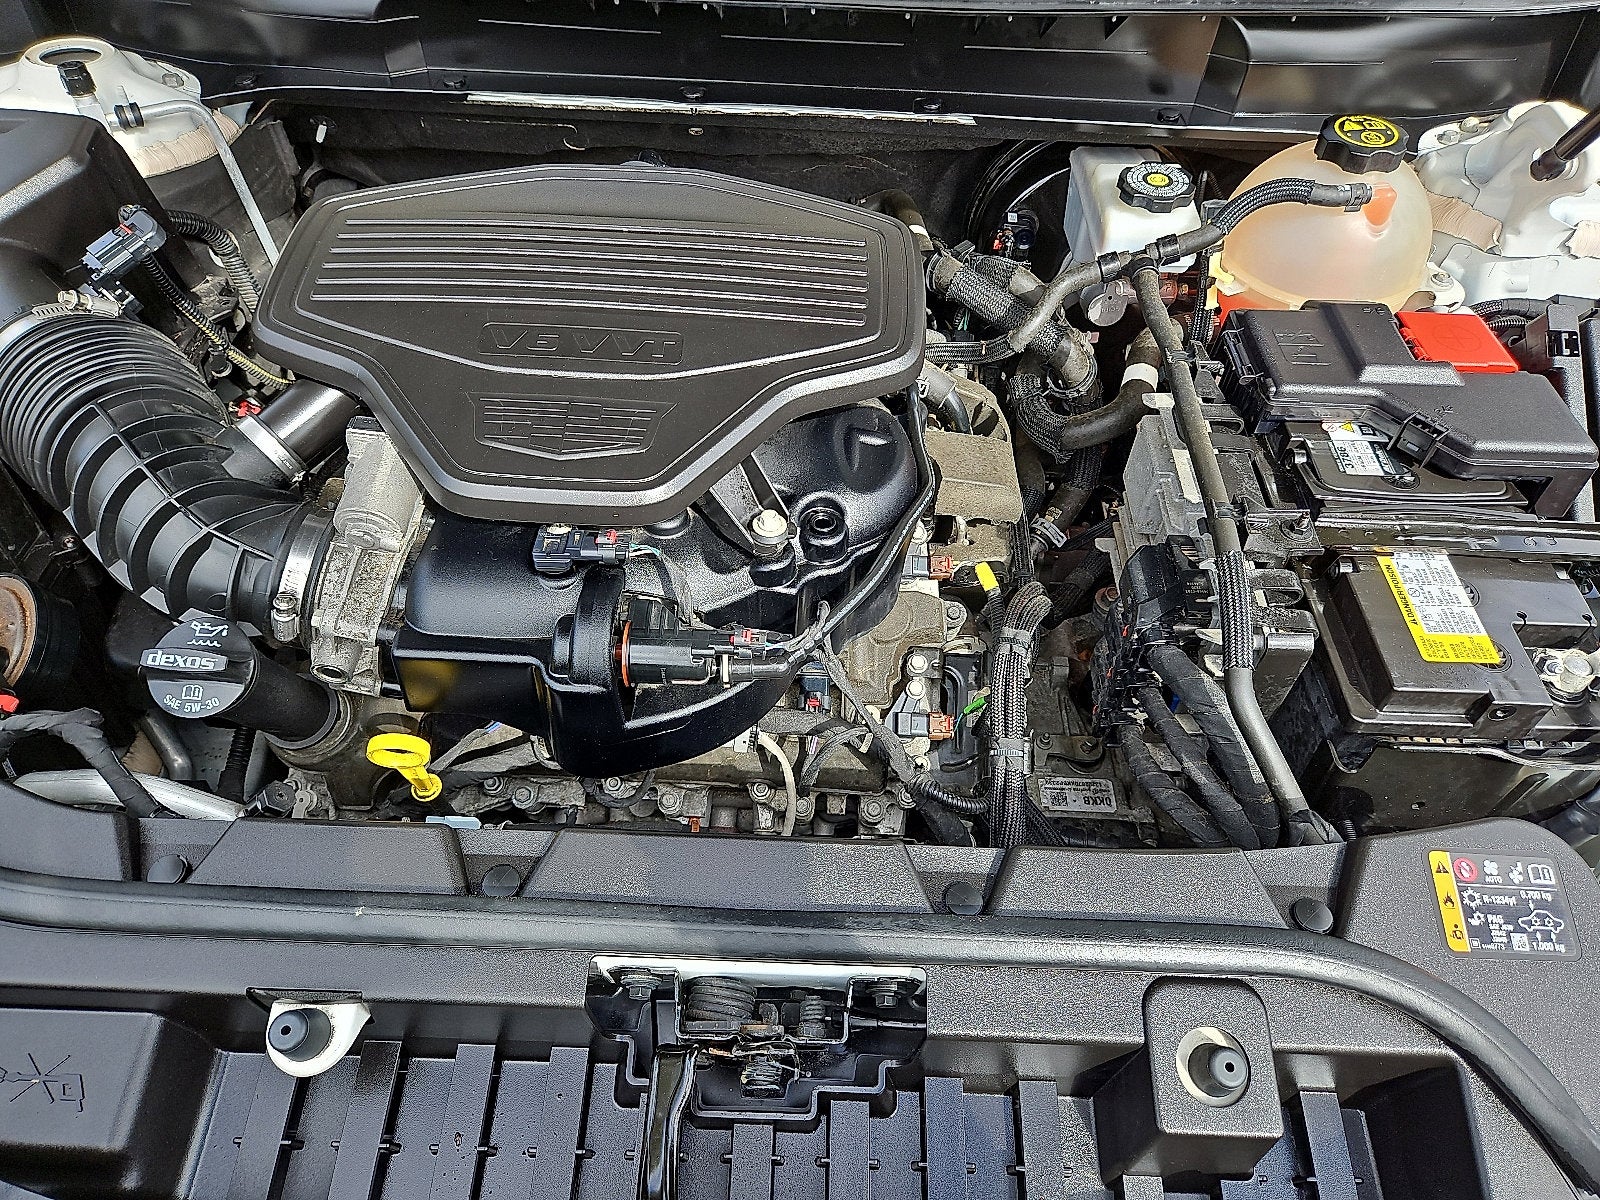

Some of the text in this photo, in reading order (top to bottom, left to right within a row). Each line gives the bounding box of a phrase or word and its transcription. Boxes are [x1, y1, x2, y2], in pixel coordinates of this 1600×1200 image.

[490, 328, 677, 359] V6 VVT
[146, 650, 219, 670] dexos
[163, 694, 220, 713] SAE 5W-30
[1484, 875, 1503, 884] AUTO
